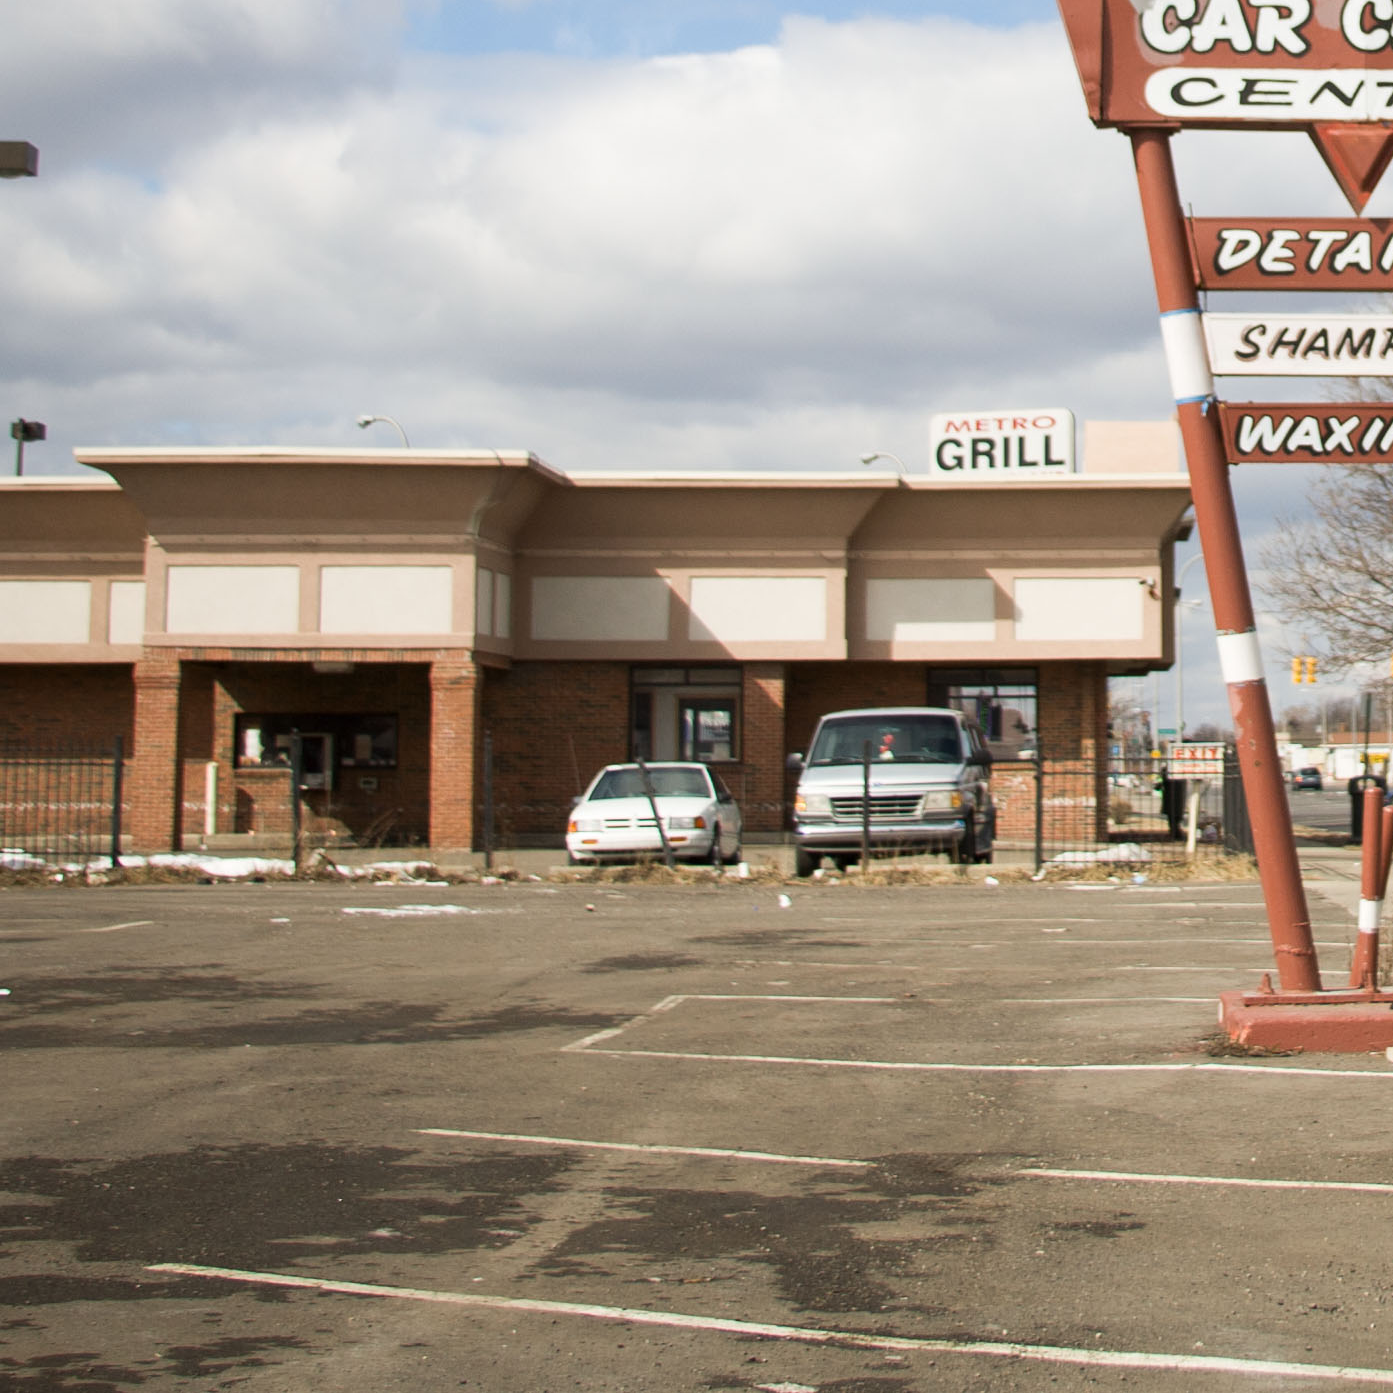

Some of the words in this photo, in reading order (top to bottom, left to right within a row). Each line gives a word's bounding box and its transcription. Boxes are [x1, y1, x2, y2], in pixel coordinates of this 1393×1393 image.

[945, 416, 1057, 433] METRO
[936, 435, 1066, 471] GRILL
[1175, 748, 1218, 760] EXIT
